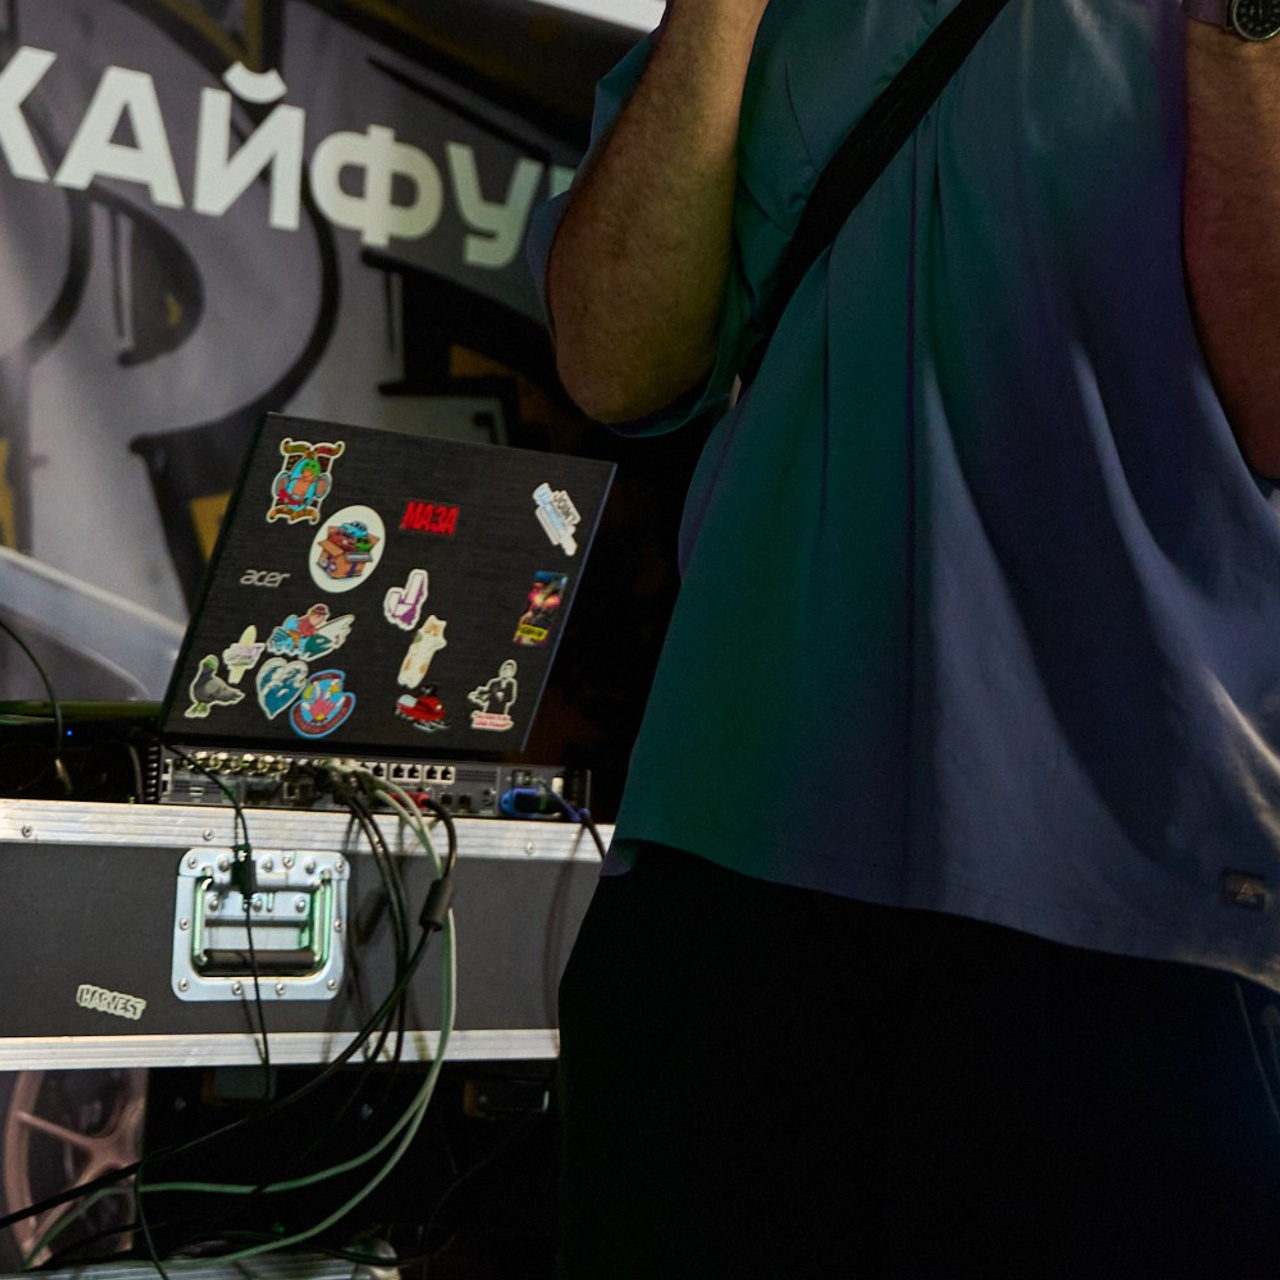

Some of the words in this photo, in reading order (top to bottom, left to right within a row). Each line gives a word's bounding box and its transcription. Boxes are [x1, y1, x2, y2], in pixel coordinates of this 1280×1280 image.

[0, 45, 577, 269] КАЙФУ
[240, 569, 291, 588] acer
[77, 984, 146, 1020] HARVEST
